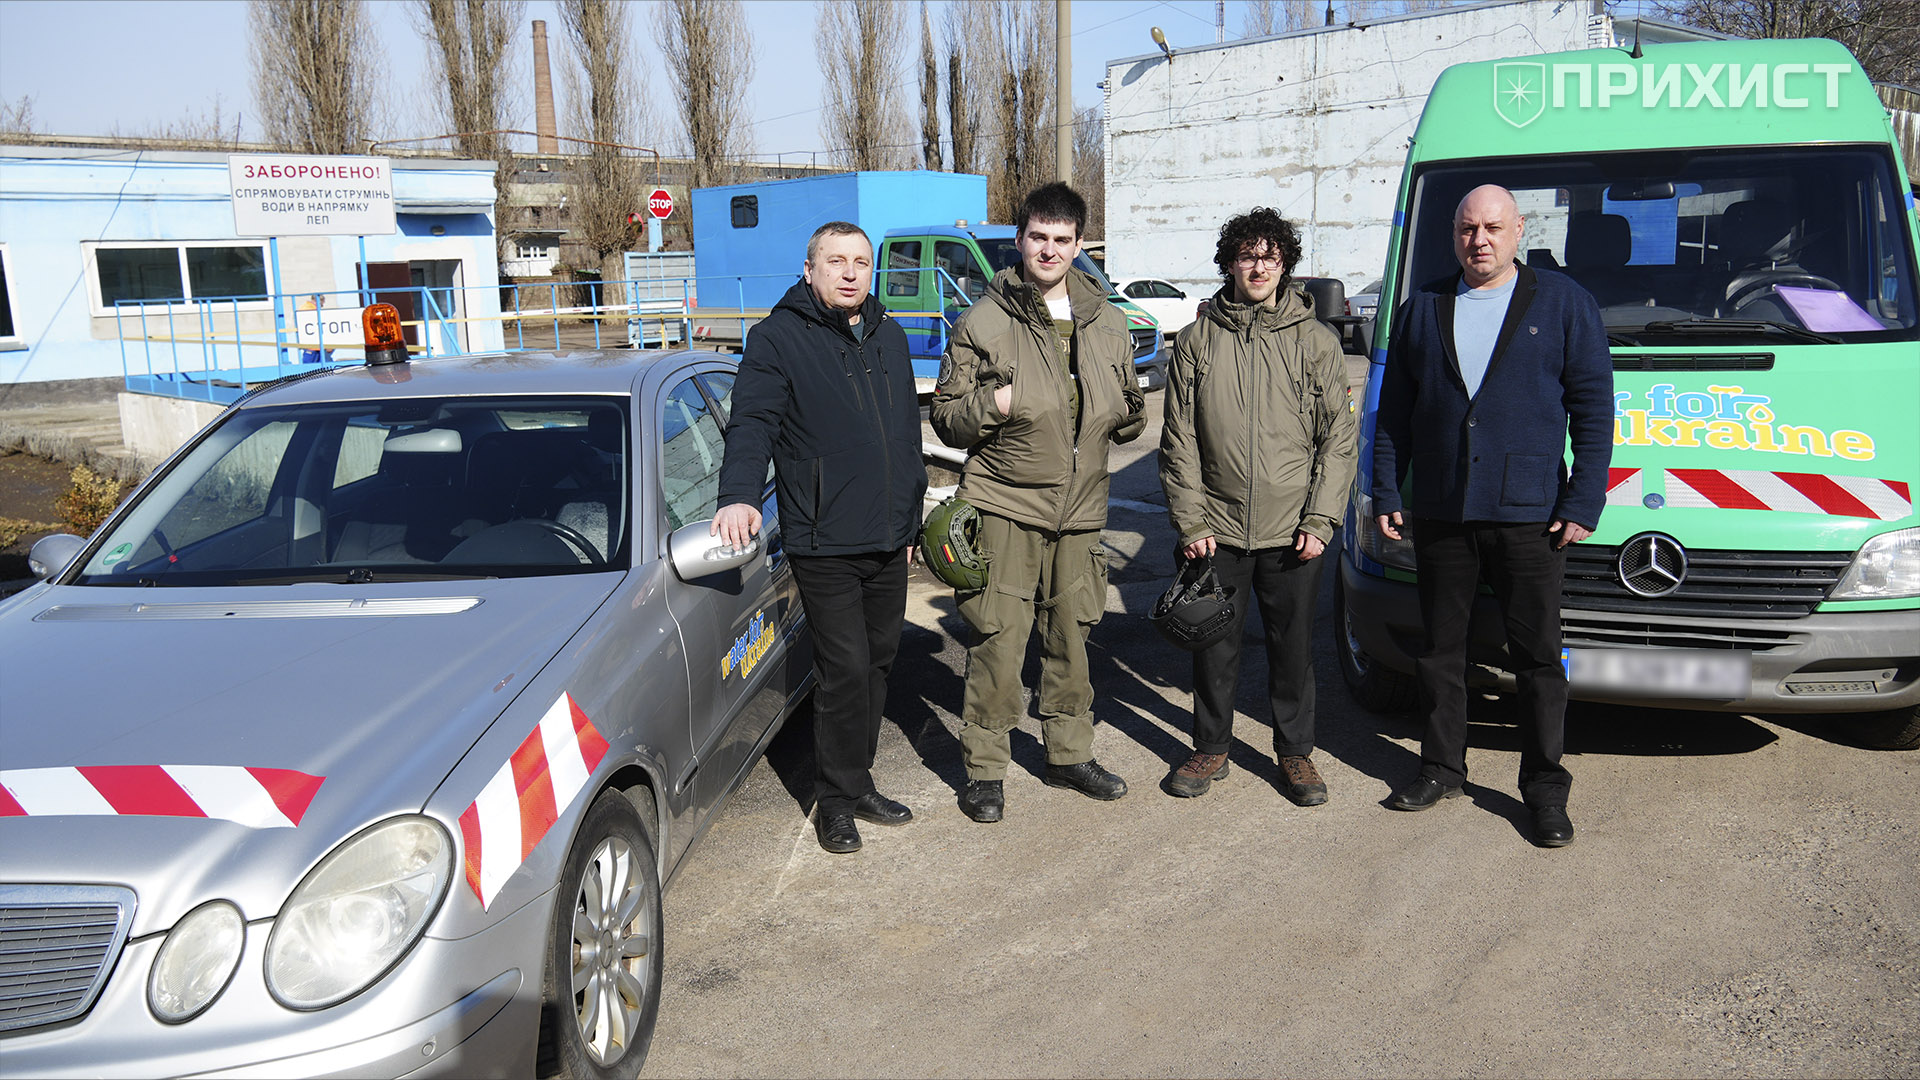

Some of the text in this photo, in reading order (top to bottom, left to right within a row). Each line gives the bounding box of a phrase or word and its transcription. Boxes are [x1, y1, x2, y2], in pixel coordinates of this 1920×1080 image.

[244, 165, 381, 179] ЗАБОРОНЕНО!
[235, 188, 390, 199] СПРЯМОВУВАТИ СТРУМІНЬ
[262, 202, 369, 212] ВОДИ В НАПРЯМКУ
[650, 199, 671, 209] STOP
[306, 215, 329, 225] ЛЕП
[1647, 385, 1771, 419] for
[721, 609, 764, 680] water for
[741, 621, 774, 679] ukraine
